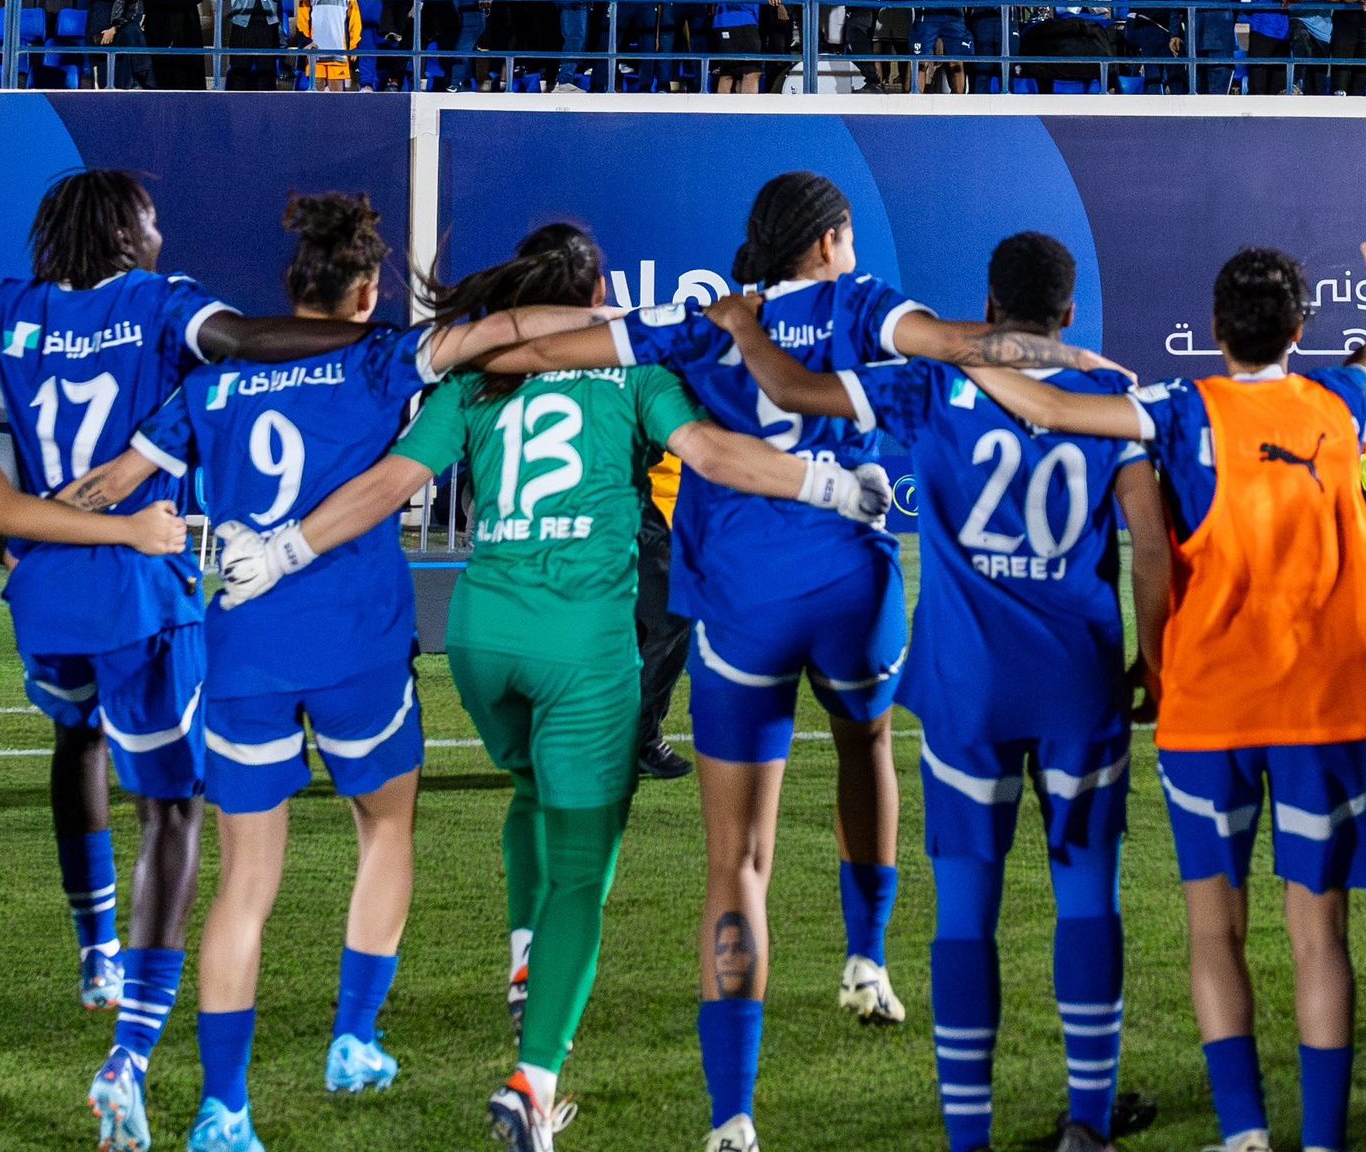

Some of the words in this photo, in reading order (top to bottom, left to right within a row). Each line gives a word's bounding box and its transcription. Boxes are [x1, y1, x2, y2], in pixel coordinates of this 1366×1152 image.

[101, 321, 143, 348] بنك
[29, 371, 120, 490] 17
[248, 409, 306, 527] 9
[494, 392, 584, 522] 13
[539, 515, 594, 541] RES
[957, 428, 1089, 559] 20
